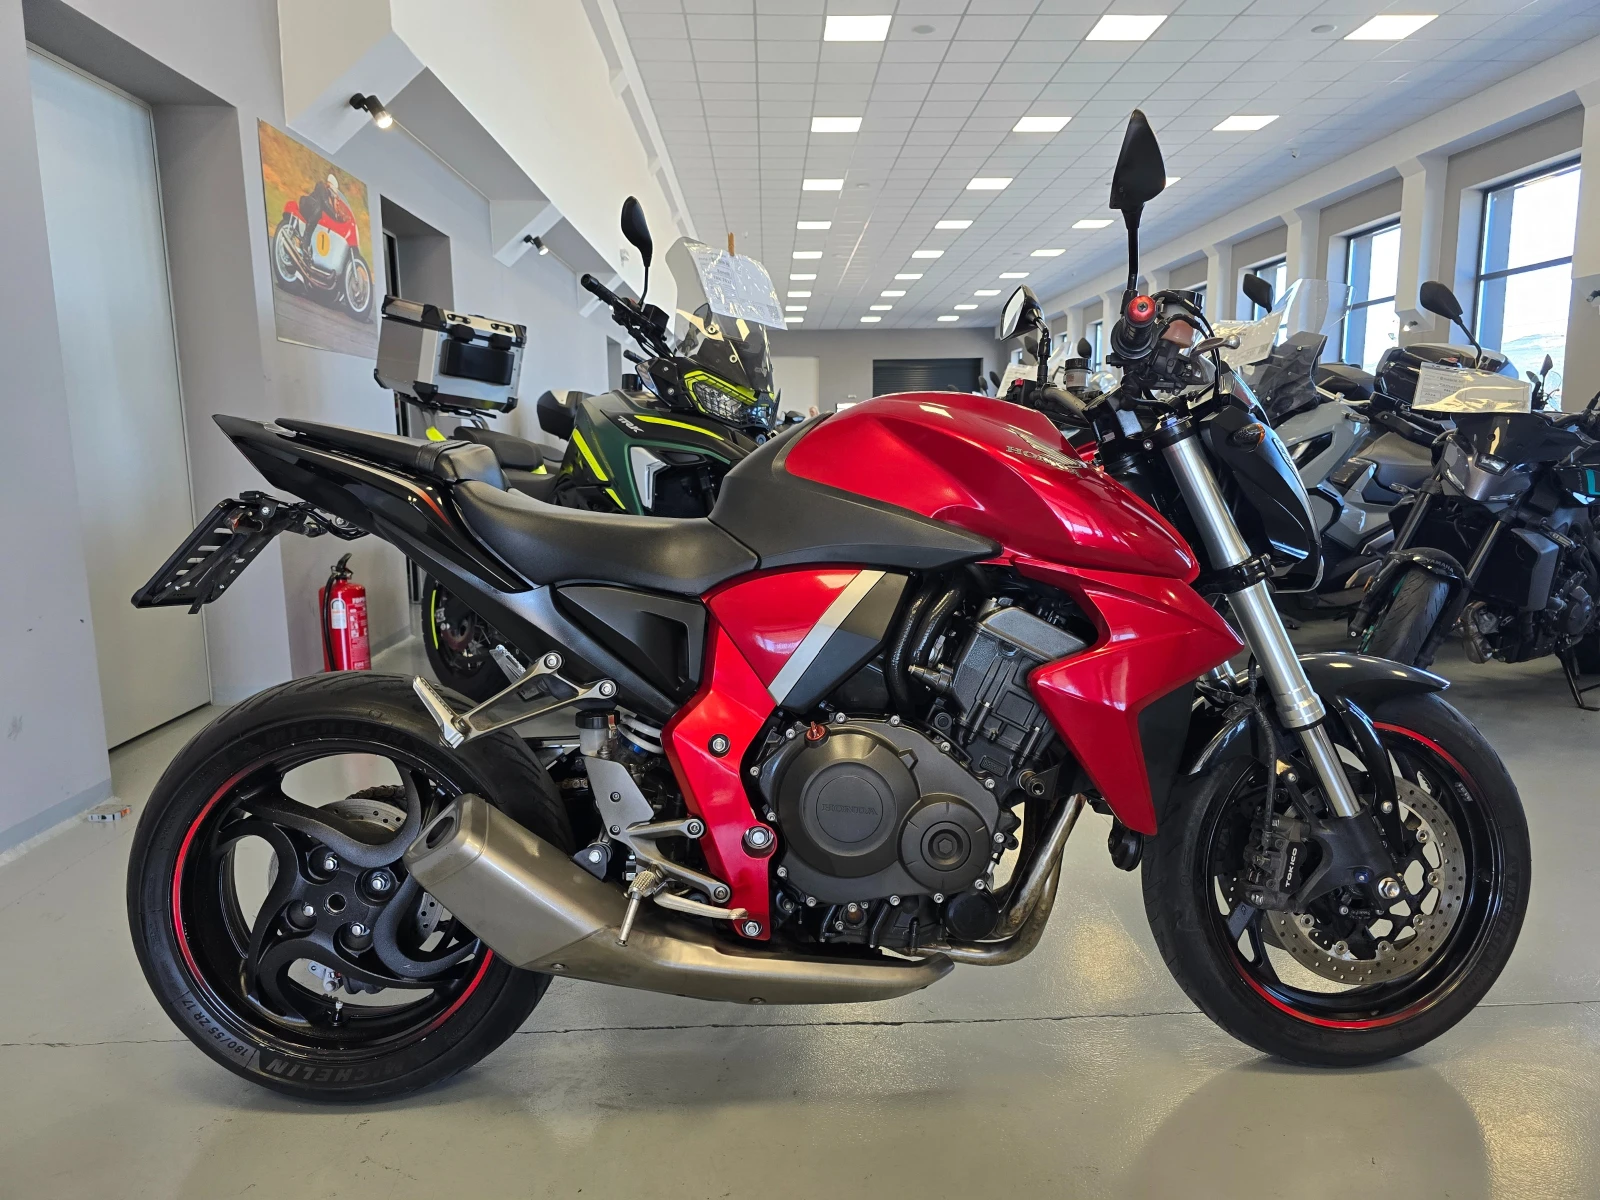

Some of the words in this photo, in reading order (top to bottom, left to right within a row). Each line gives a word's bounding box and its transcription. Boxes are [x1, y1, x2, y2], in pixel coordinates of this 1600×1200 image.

[617, 415, 645, 433] TRK
[1426, 558, 1454, 573] YAMAHA
[821, 803, 879, 816] HONDA
[1285, 847, 1298, 888] TOKICO
[181, 999, 197, 1011] 17
[193, 1011, 211, 1027] ZR
[208, 1026, 250, 1057] 180/55
[265, 1057, 406, 1083] MICHELIN
